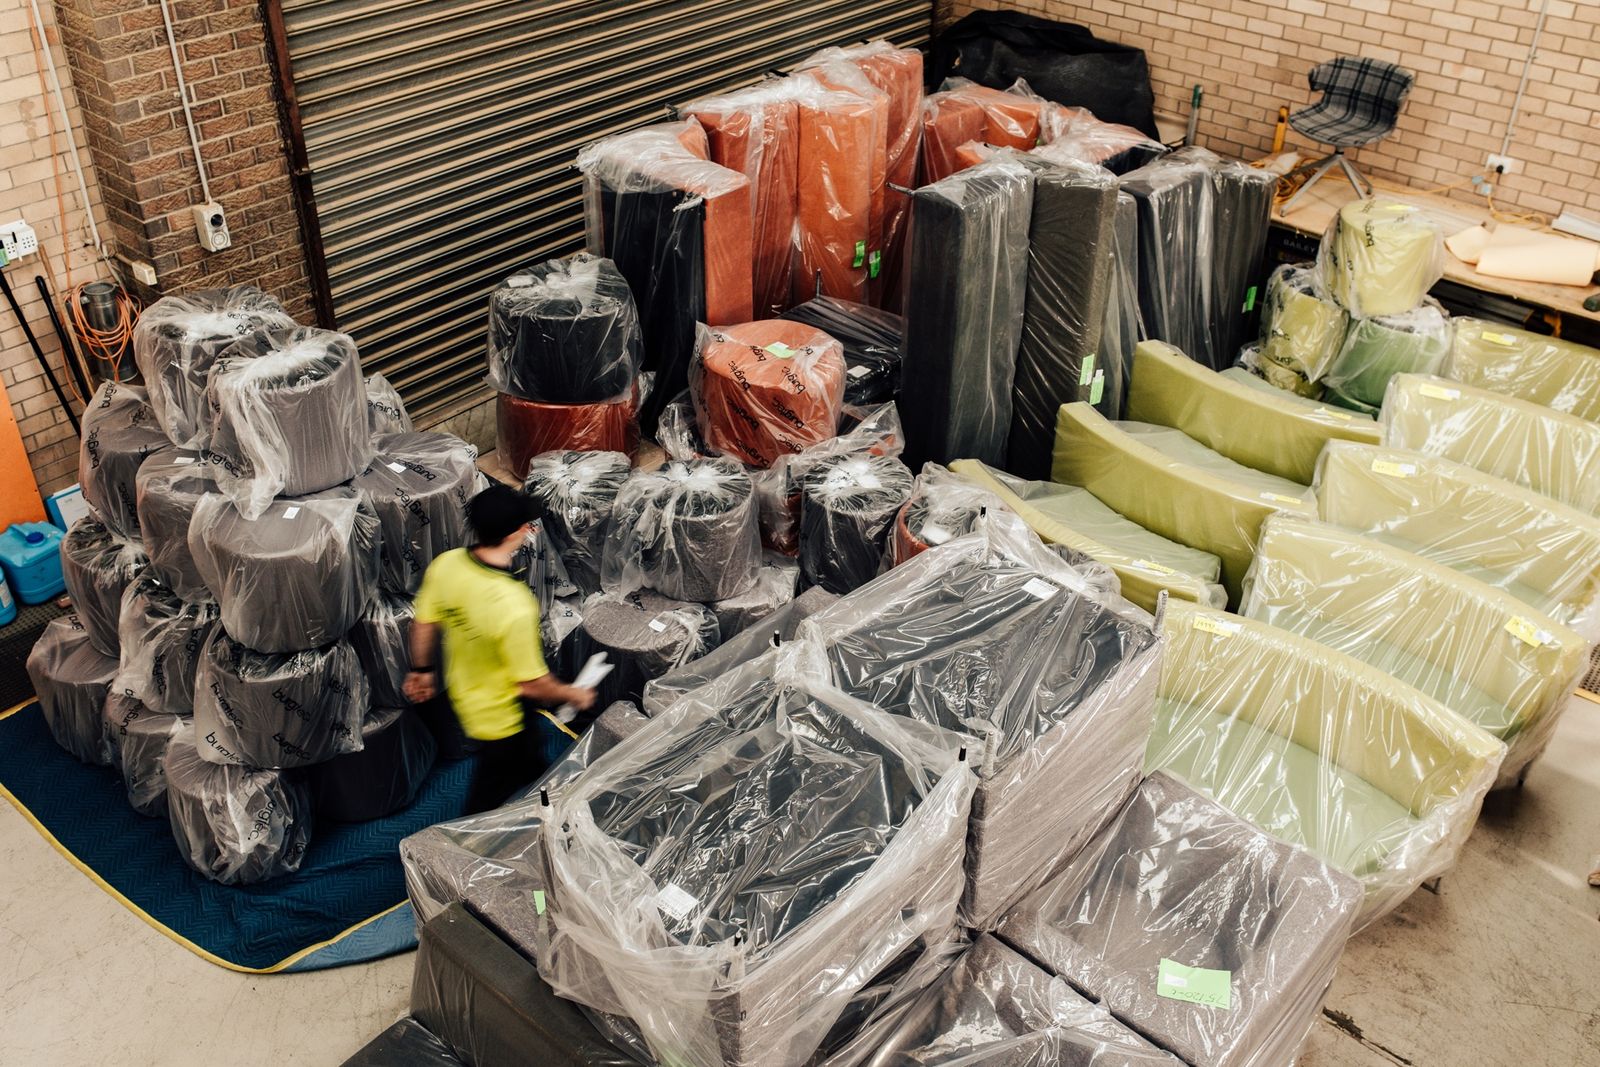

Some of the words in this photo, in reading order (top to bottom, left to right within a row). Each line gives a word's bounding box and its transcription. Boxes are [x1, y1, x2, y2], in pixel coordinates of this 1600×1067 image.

[207, 450, 240, 478] rgtec.
[394, 486, 431, 527] burgtec.
[246, 800, 278, 841] urgtec.
